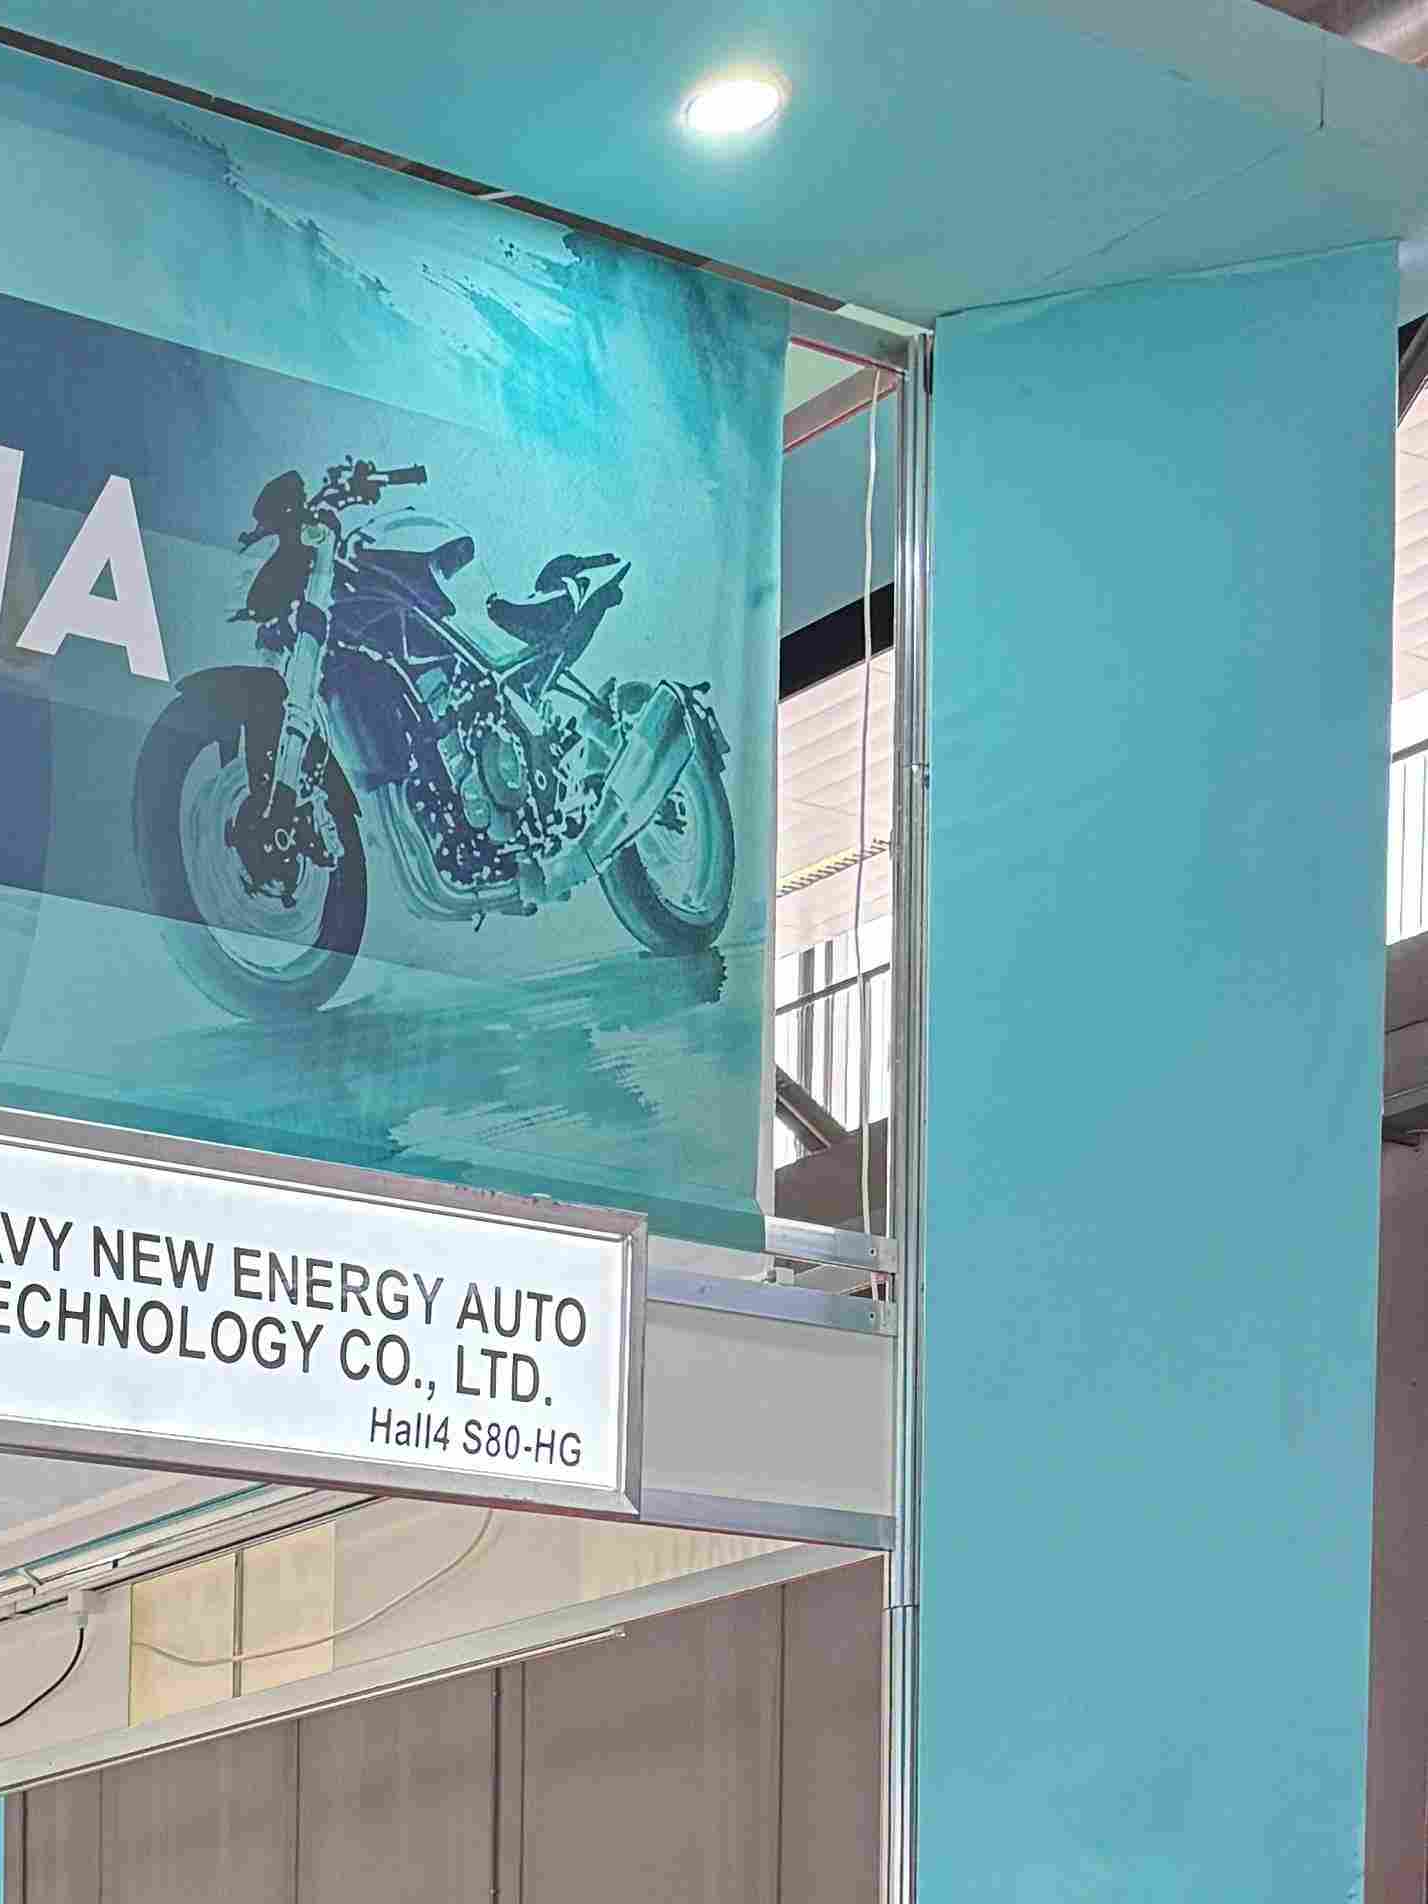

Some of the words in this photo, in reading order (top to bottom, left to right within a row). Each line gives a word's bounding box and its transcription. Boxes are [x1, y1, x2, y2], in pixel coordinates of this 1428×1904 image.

[92, 1228, 213, 1292] NEW
[234, 1247, 443, 1323] ENERGY
[457, 1282, 586, 1348] AUTO
[339, 1331, 438, 1403] CO.,
[454, 1345, 551, 1407] LTD.
[368, 1406, 450, 1451] Hall4
[462, 1417, 582, 1468] S80-HG
